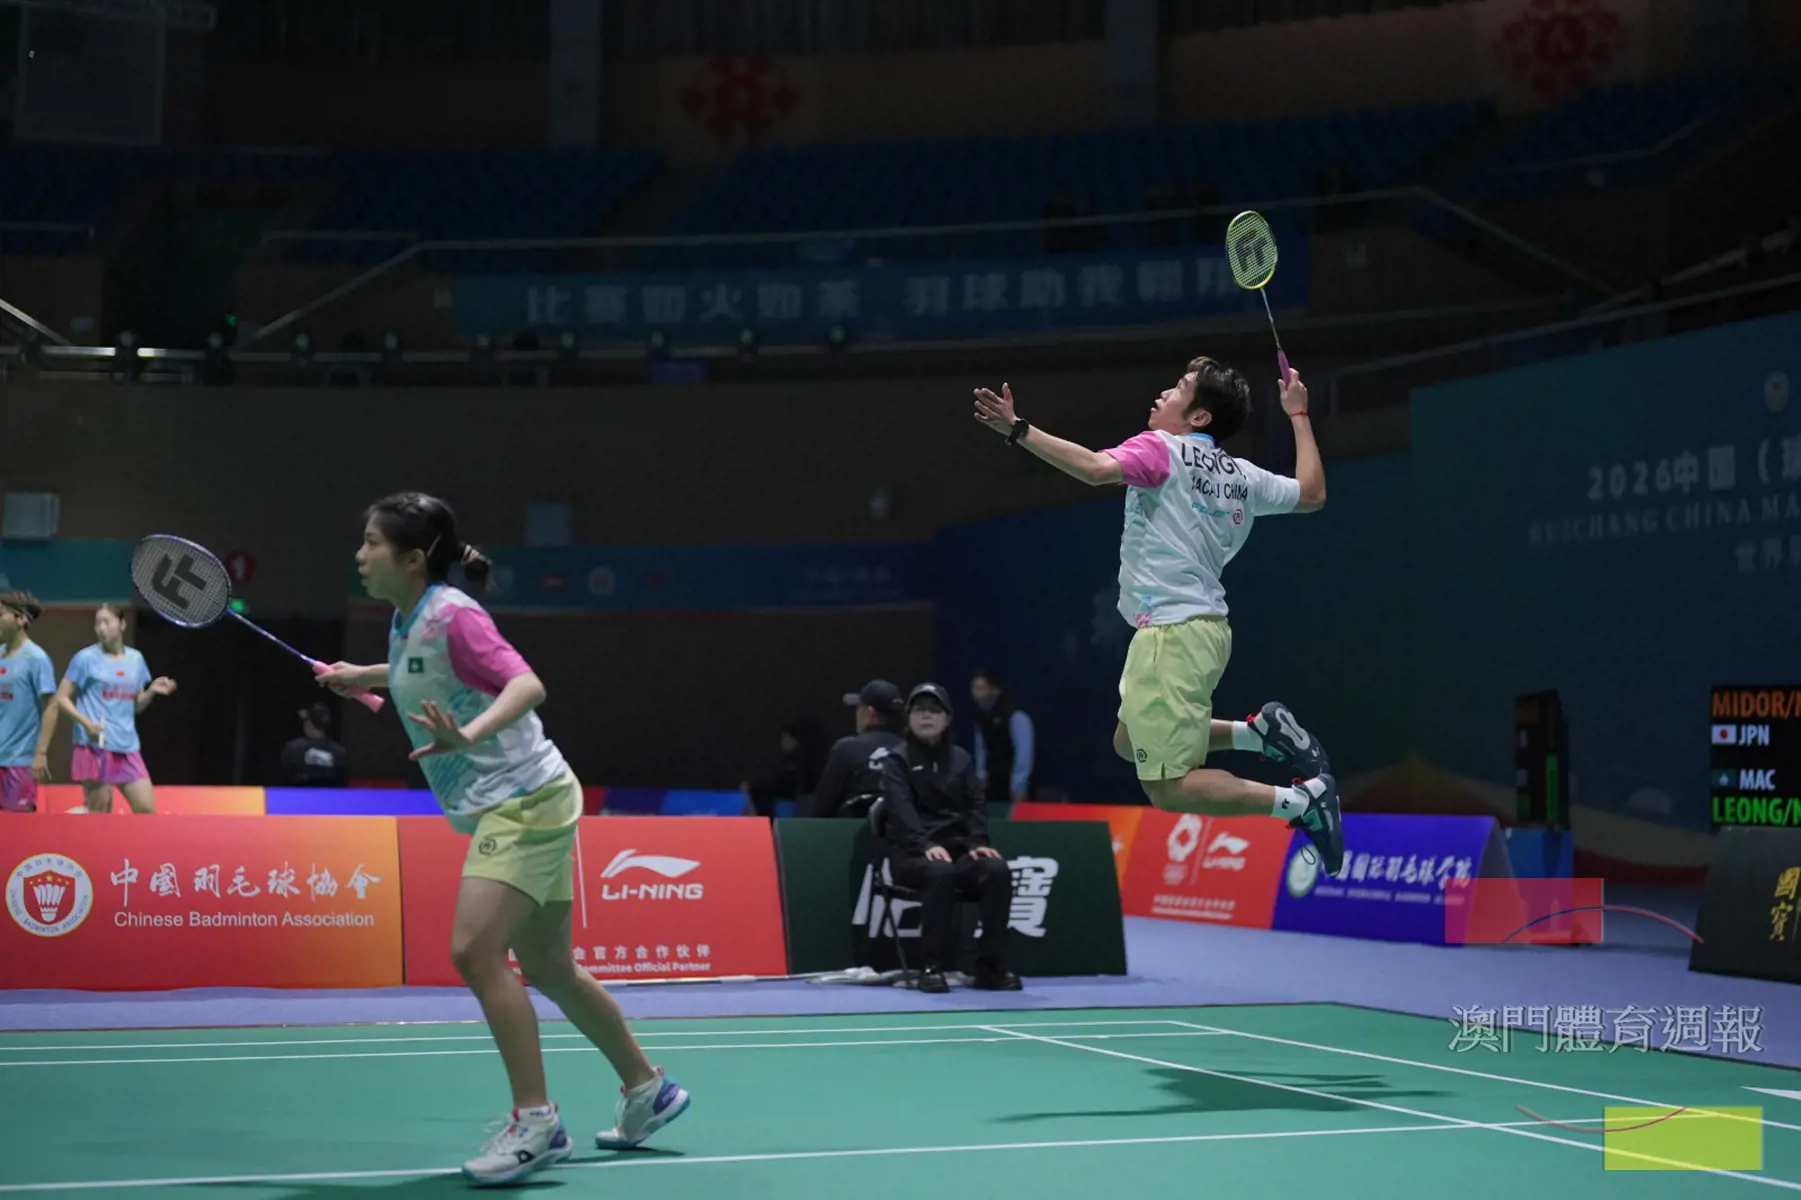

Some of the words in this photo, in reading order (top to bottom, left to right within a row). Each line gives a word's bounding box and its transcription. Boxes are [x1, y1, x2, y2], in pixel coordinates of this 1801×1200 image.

[1738, 723, 1770, 746] JPN
[1739, 769, 1776, 791] MAC
[602, 883, 703, 900] LI-NING
[114, 911, 183, 927] Chinese
[189, 911, 277, 927] Badminton
[282, 911, 374, 927] Association
